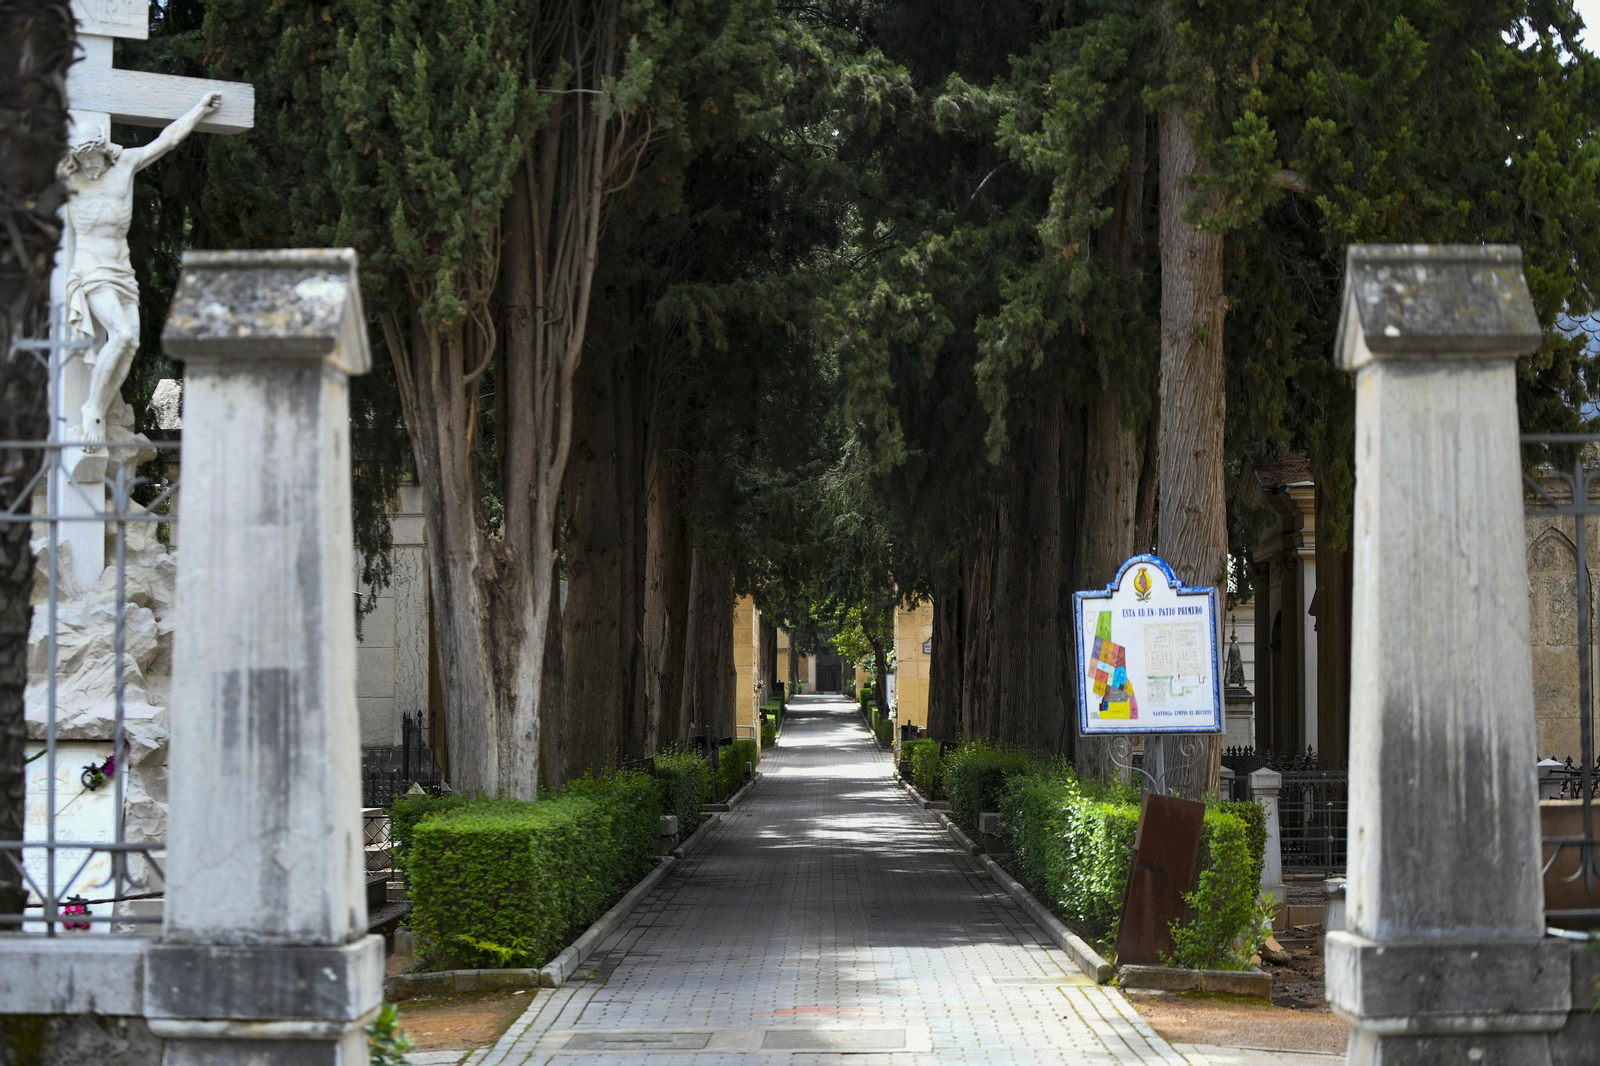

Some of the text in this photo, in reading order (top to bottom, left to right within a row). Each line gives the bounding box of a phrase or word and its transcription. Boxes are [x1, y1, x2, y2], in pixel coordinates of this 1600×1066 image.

[1122, 609, 1135, 618] ESTA
[1159, 607, 1176, 616] PATIO
[1178, 606, 1203, 615] PRIMERO
